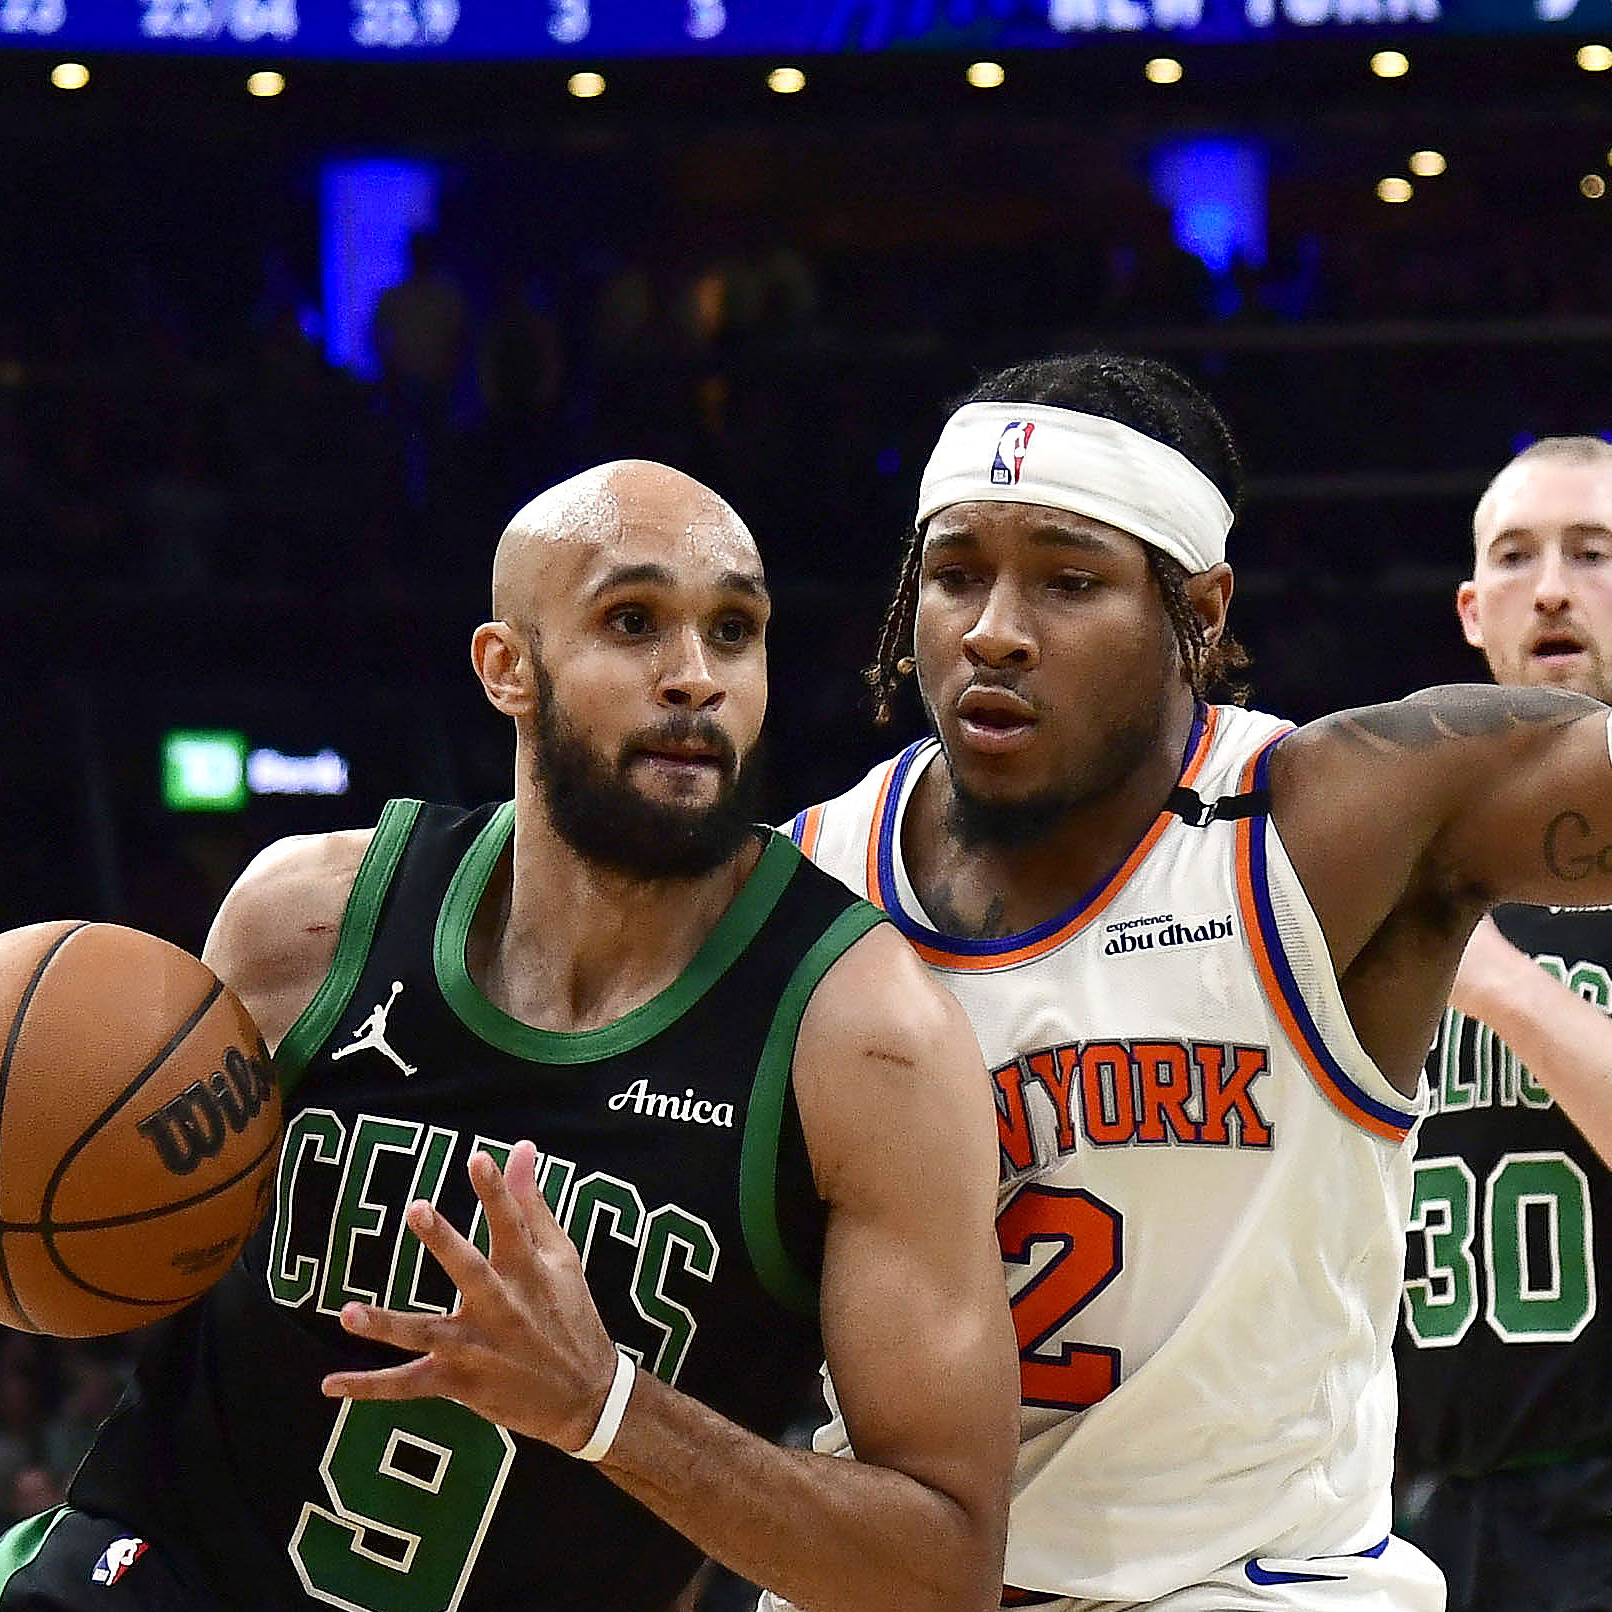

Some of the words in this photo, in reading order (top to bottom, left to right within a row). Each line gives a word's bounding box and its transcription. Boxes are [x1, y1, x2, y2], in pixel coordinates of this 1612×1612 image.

[1104, 931, 1154, 956] abu
[1158, 914, 1234, 947] dhabi
[1106, 914, 1173, 933] experience
[608, 1078, 734, 1128] Amica
[1025, 1037, 1277, 1155] YORK
[1403, 1151, 1597, 1349] 30
[995, 1182, 1124, 1412] 2
